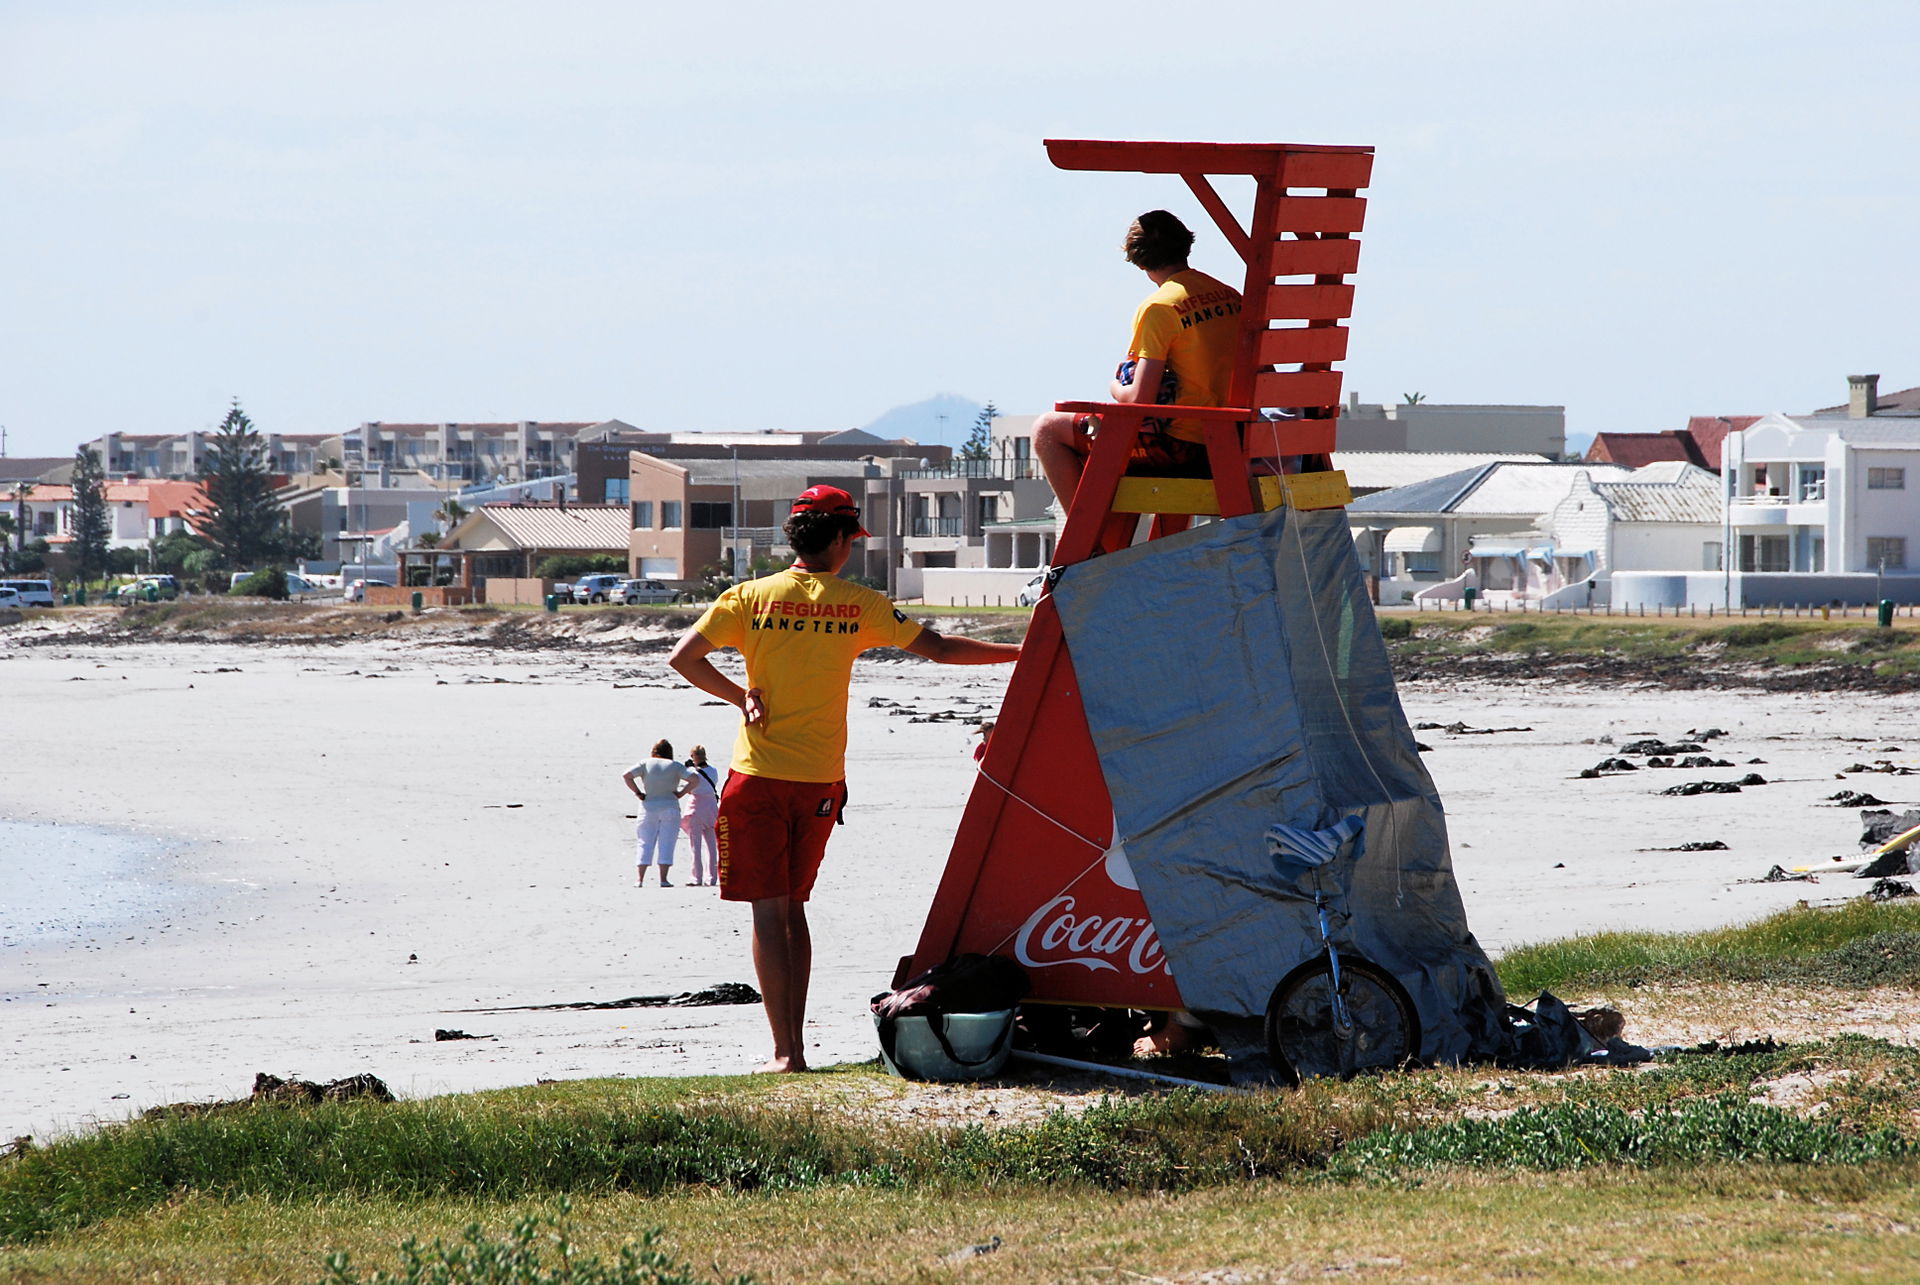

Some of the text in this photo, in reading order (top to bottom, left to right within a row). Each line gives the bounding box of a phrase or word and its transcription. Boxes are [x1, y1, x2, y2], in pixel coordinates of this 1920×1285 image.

[1181, 305, 1224, 329] HANG
[752, 601, 861, 618] LIFEGUARD
[752, 617, 805, 632] HANG
[719, 815, 730, 886] LIFEGUARD
[1014, 895, 1174, 976] Coca-C
